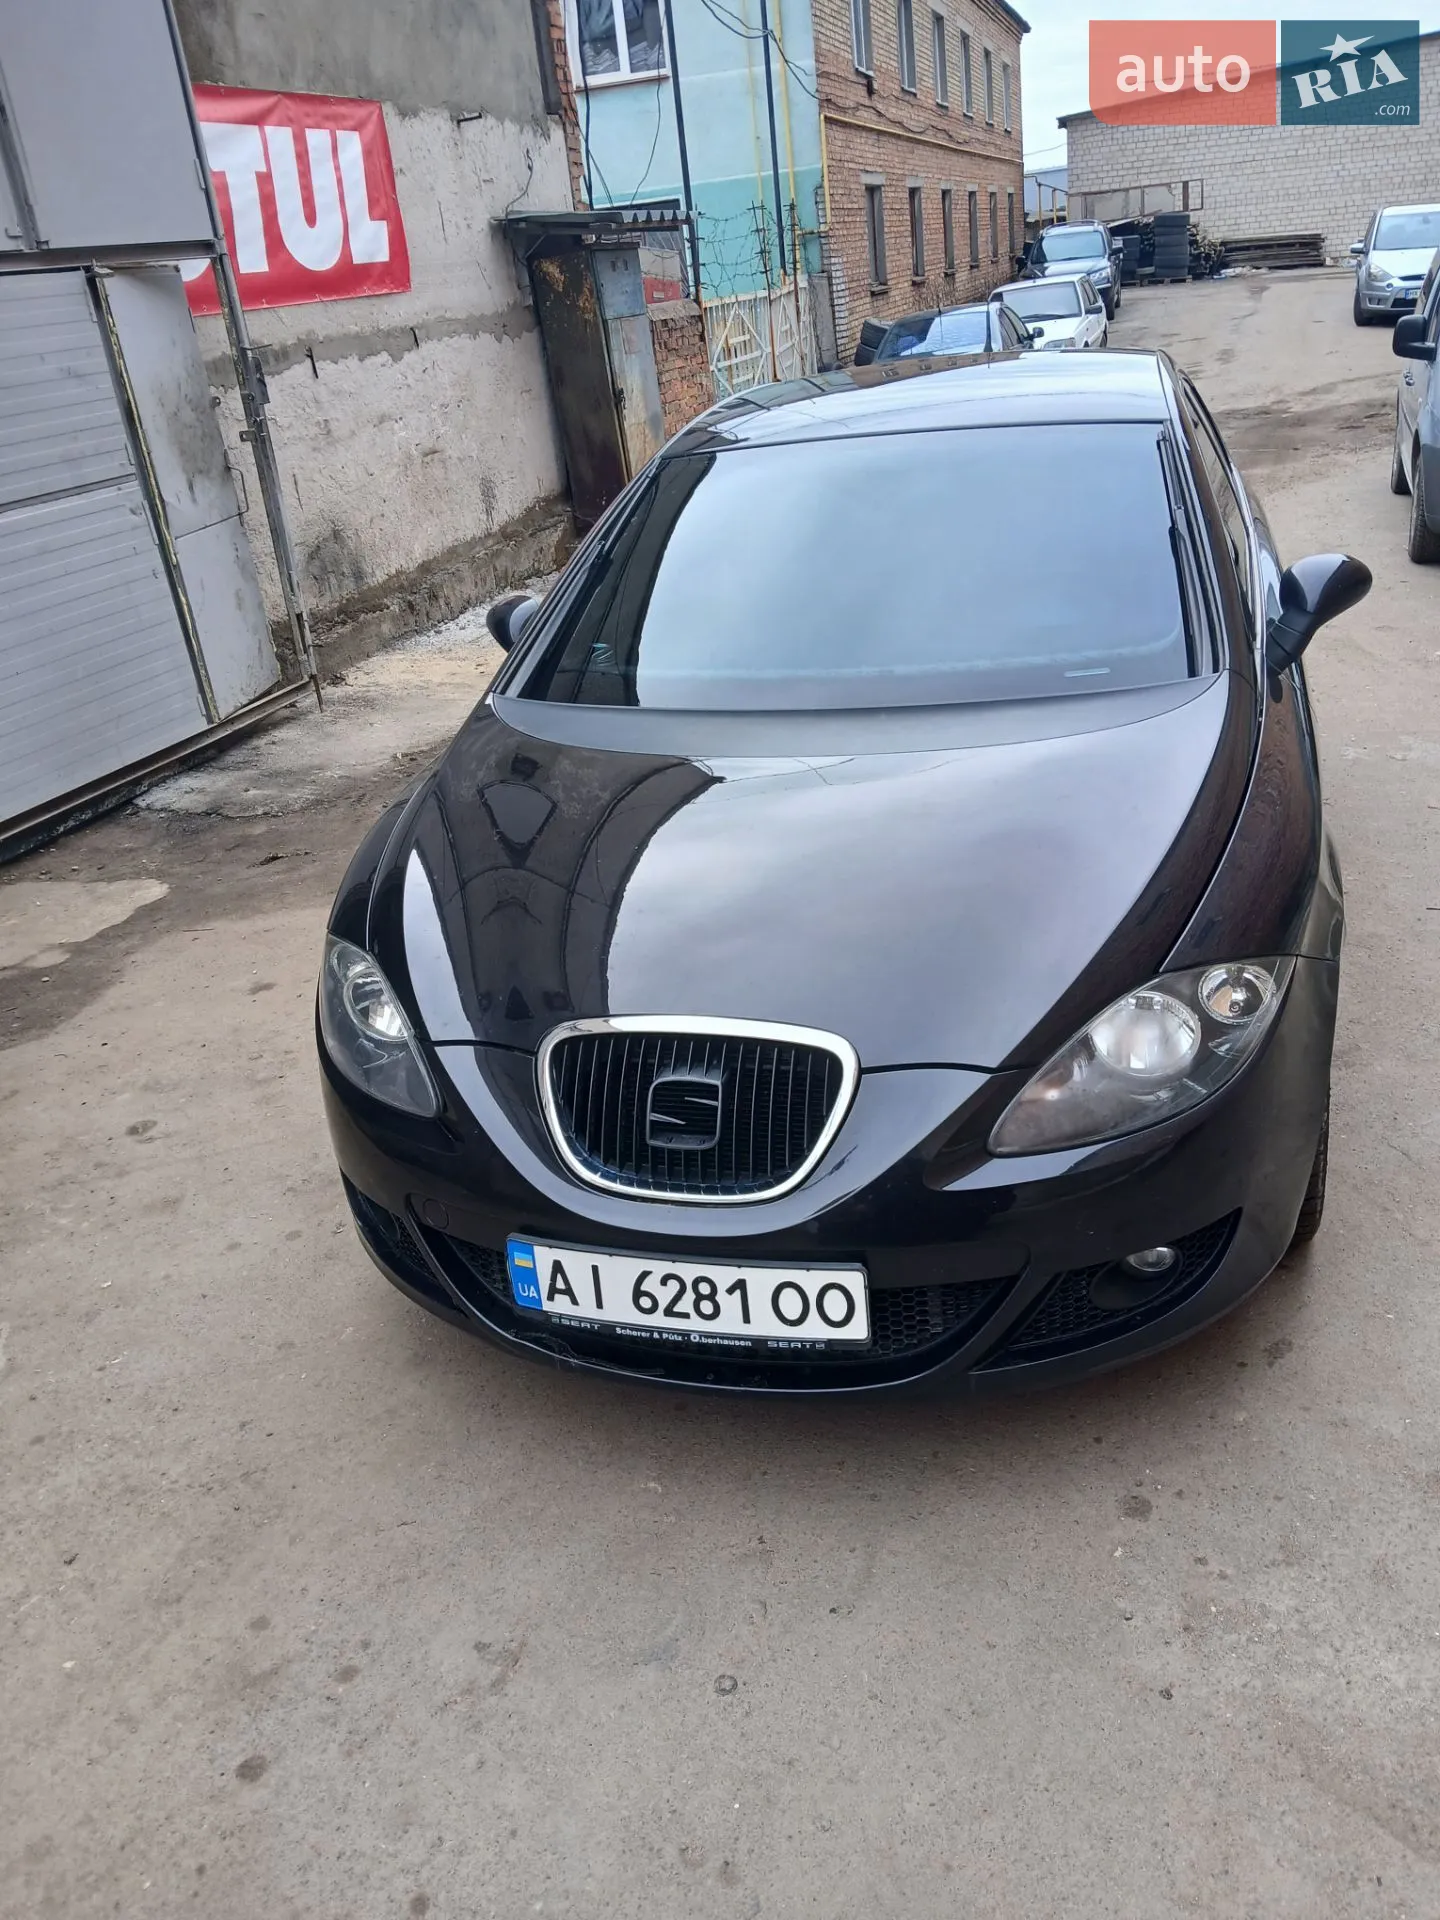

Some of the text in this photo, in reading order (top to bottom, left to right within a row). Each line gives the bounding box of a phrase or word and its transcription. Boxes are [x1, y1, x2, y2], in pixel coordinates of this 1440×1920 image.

[517, 1282, 540, 1299] UA
[546, 1259, 856, 1328] AI 6281 OO
[561, 1318, 601, 1331] SEAT
[653, 1331, 660, 1339] &
[767, 1341, 814, 1349] SEAT
